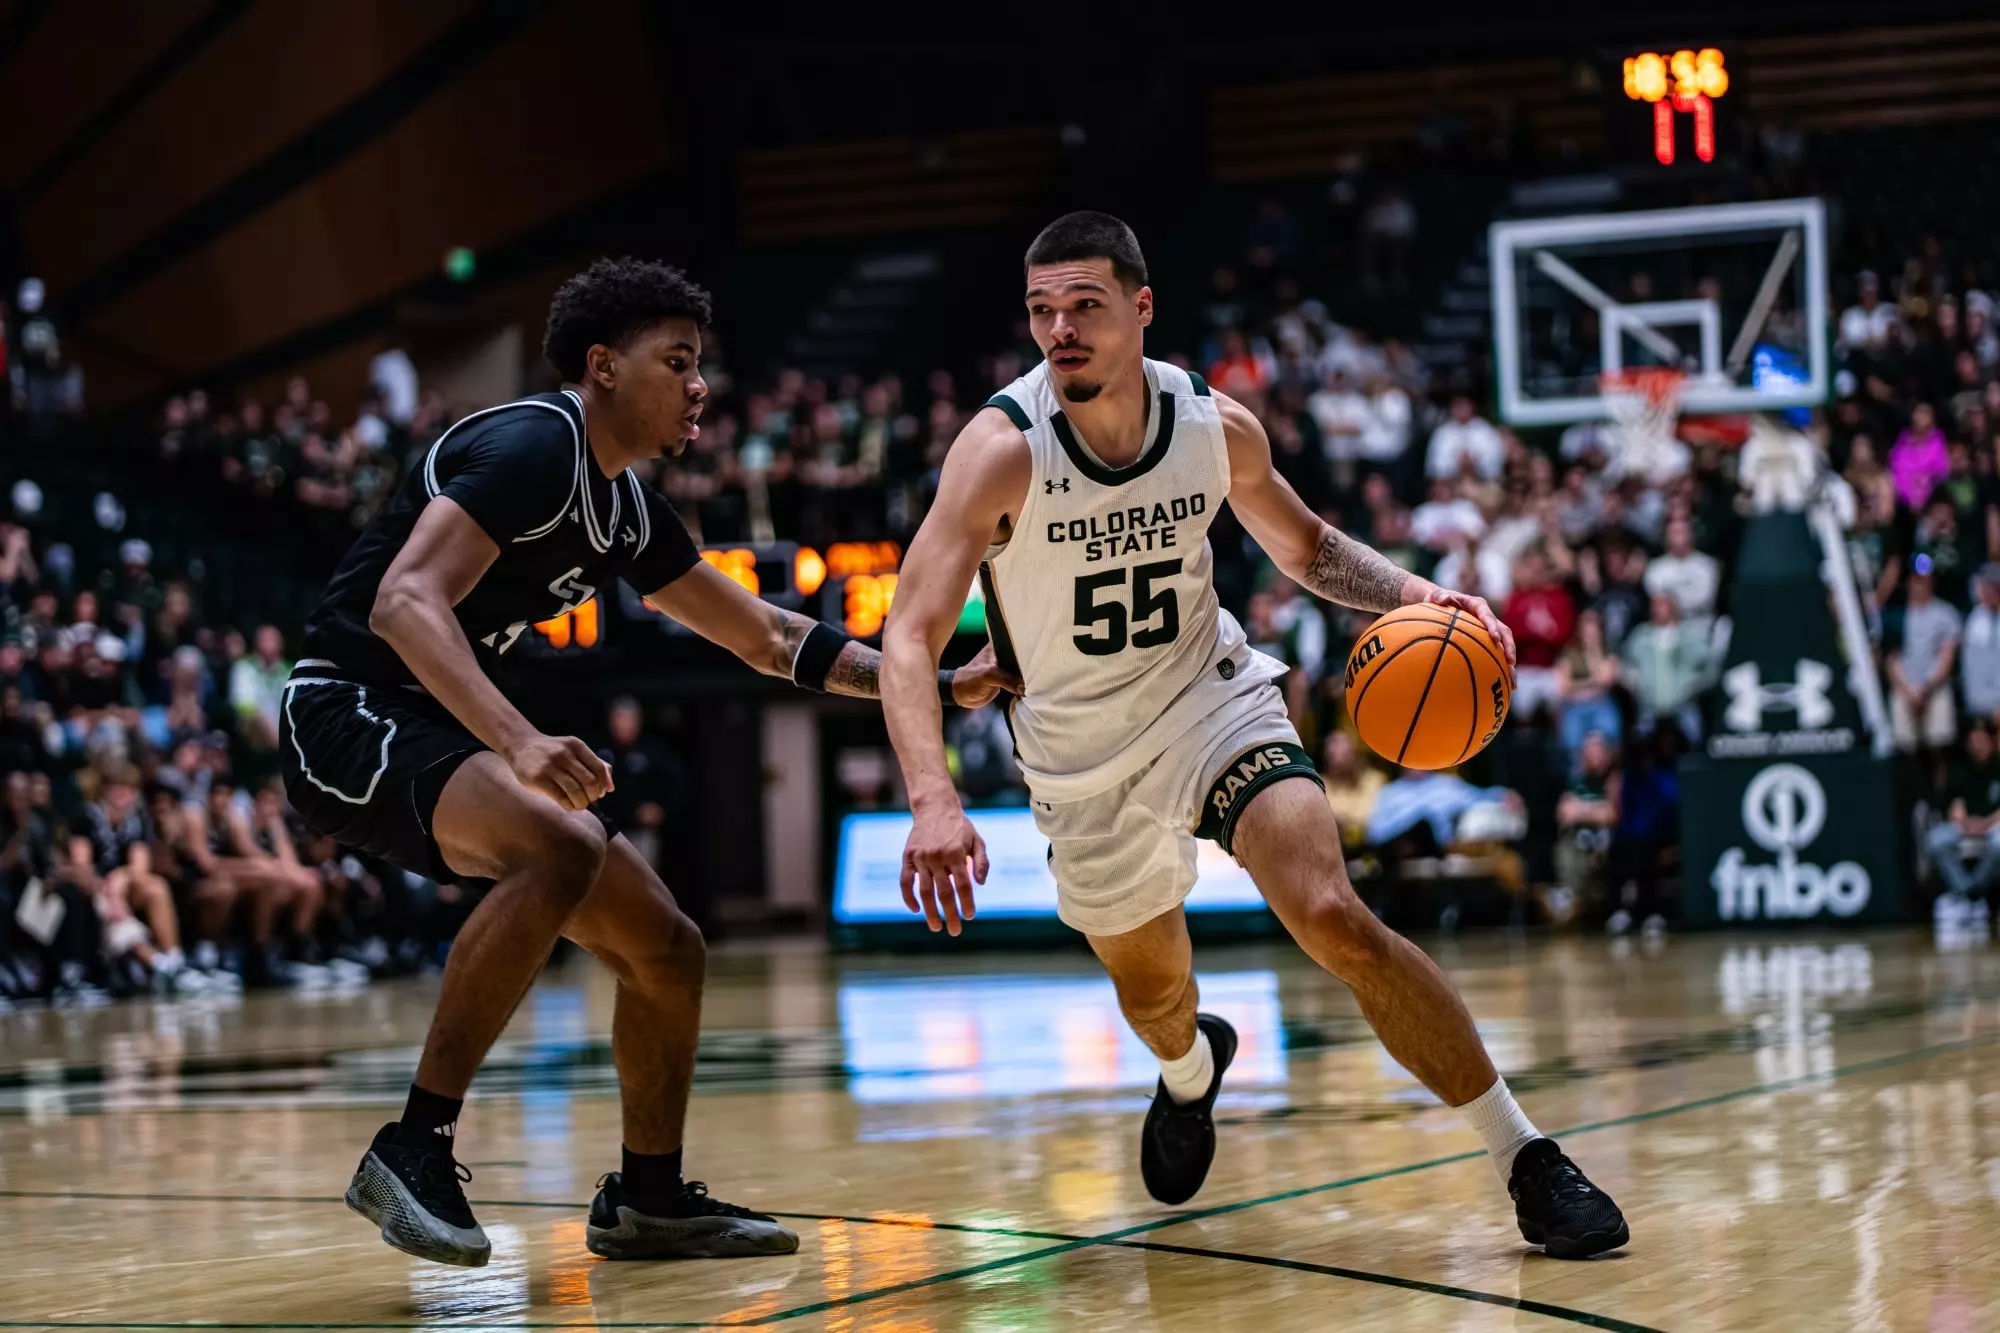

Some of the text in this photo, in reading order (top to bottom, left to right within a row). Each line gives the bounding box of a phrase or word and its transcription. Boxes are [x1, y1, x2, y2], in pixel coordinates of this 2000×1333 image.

[1047, 493, 1206, 543] COLORADO
[1086, 526, 1177, 562] STATE
[1073, 558, 1184, 656] 55
[1212, 746, 1292, 820] RAMS
[1709, 846, 1872, 920] fnbo
